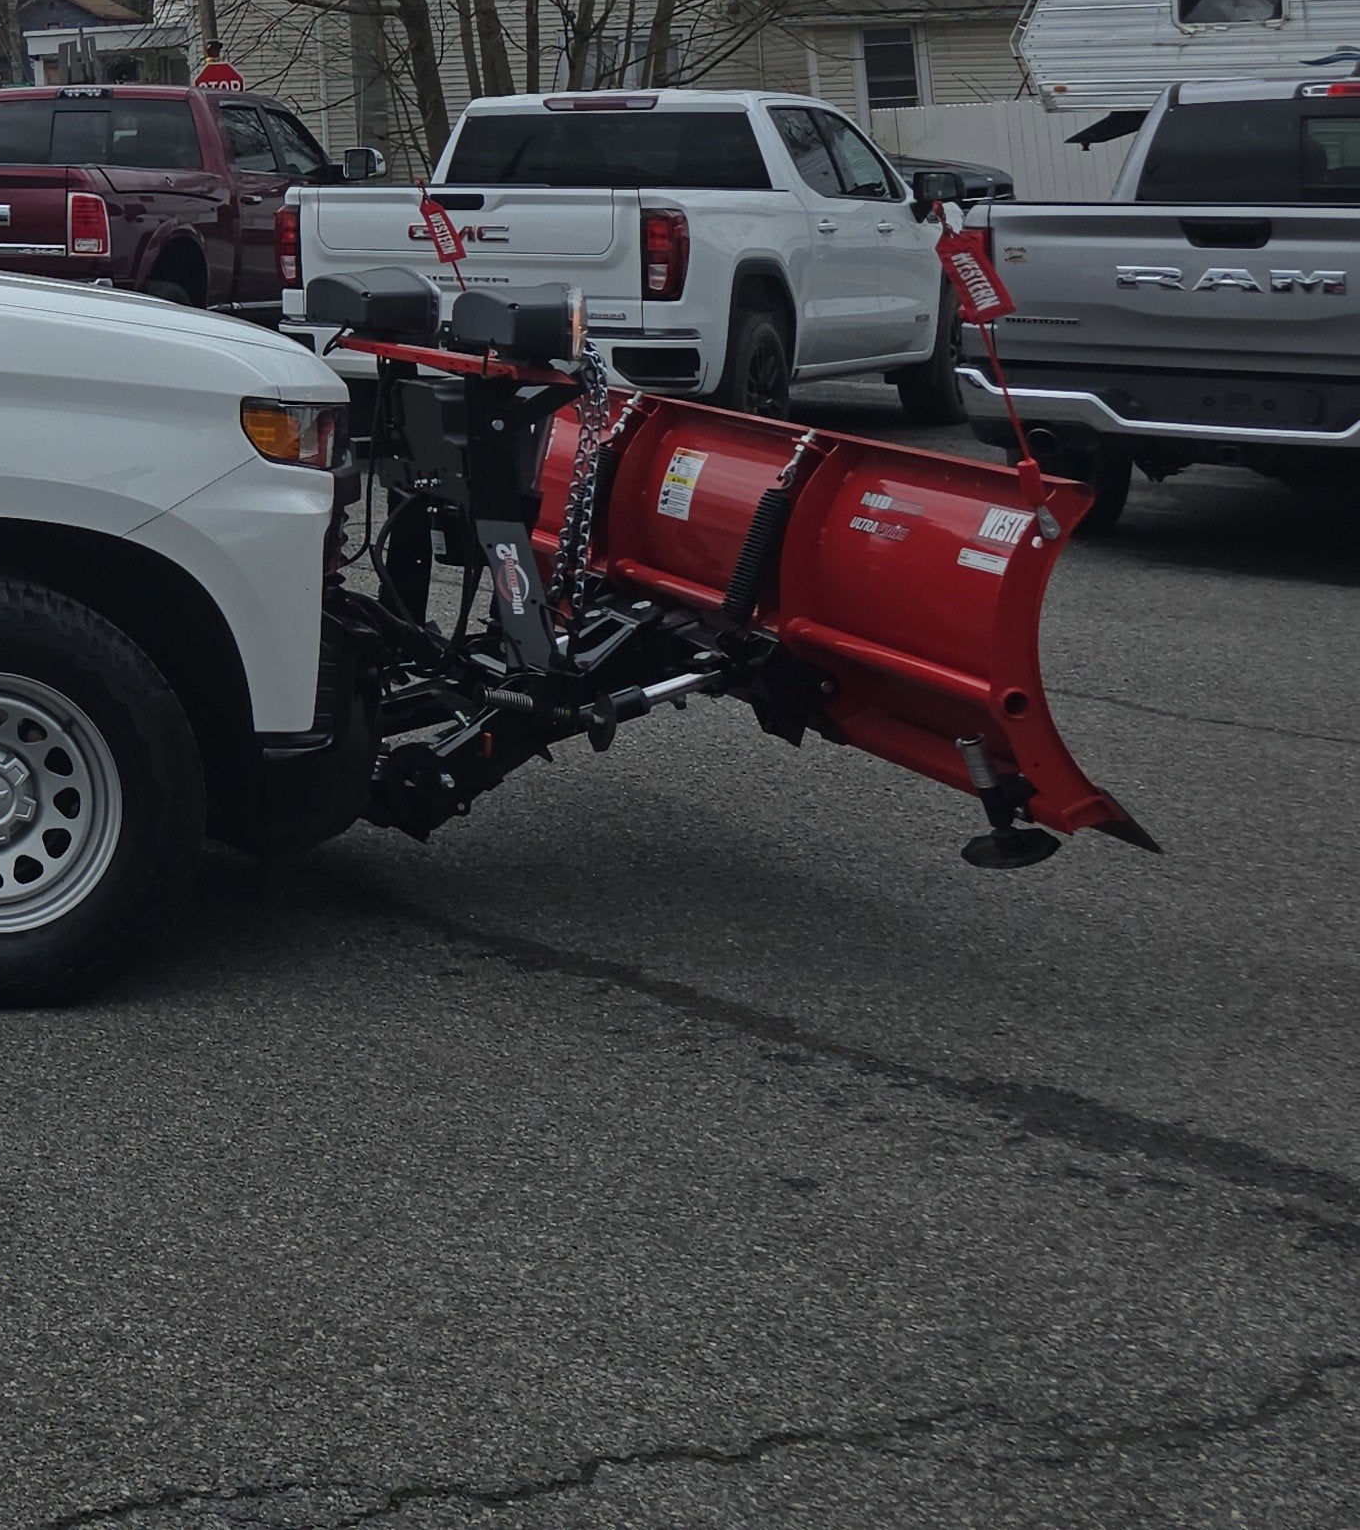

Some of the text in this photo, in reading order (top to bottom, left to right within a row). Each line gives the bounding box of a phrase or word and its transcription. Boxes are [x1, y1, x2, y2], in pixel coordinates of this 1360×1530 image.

[428, 212, 458, 256] WESTERN
[950, 252, 1001, 312] WESTERN
[1115, 265, 1348, 296] RAM
